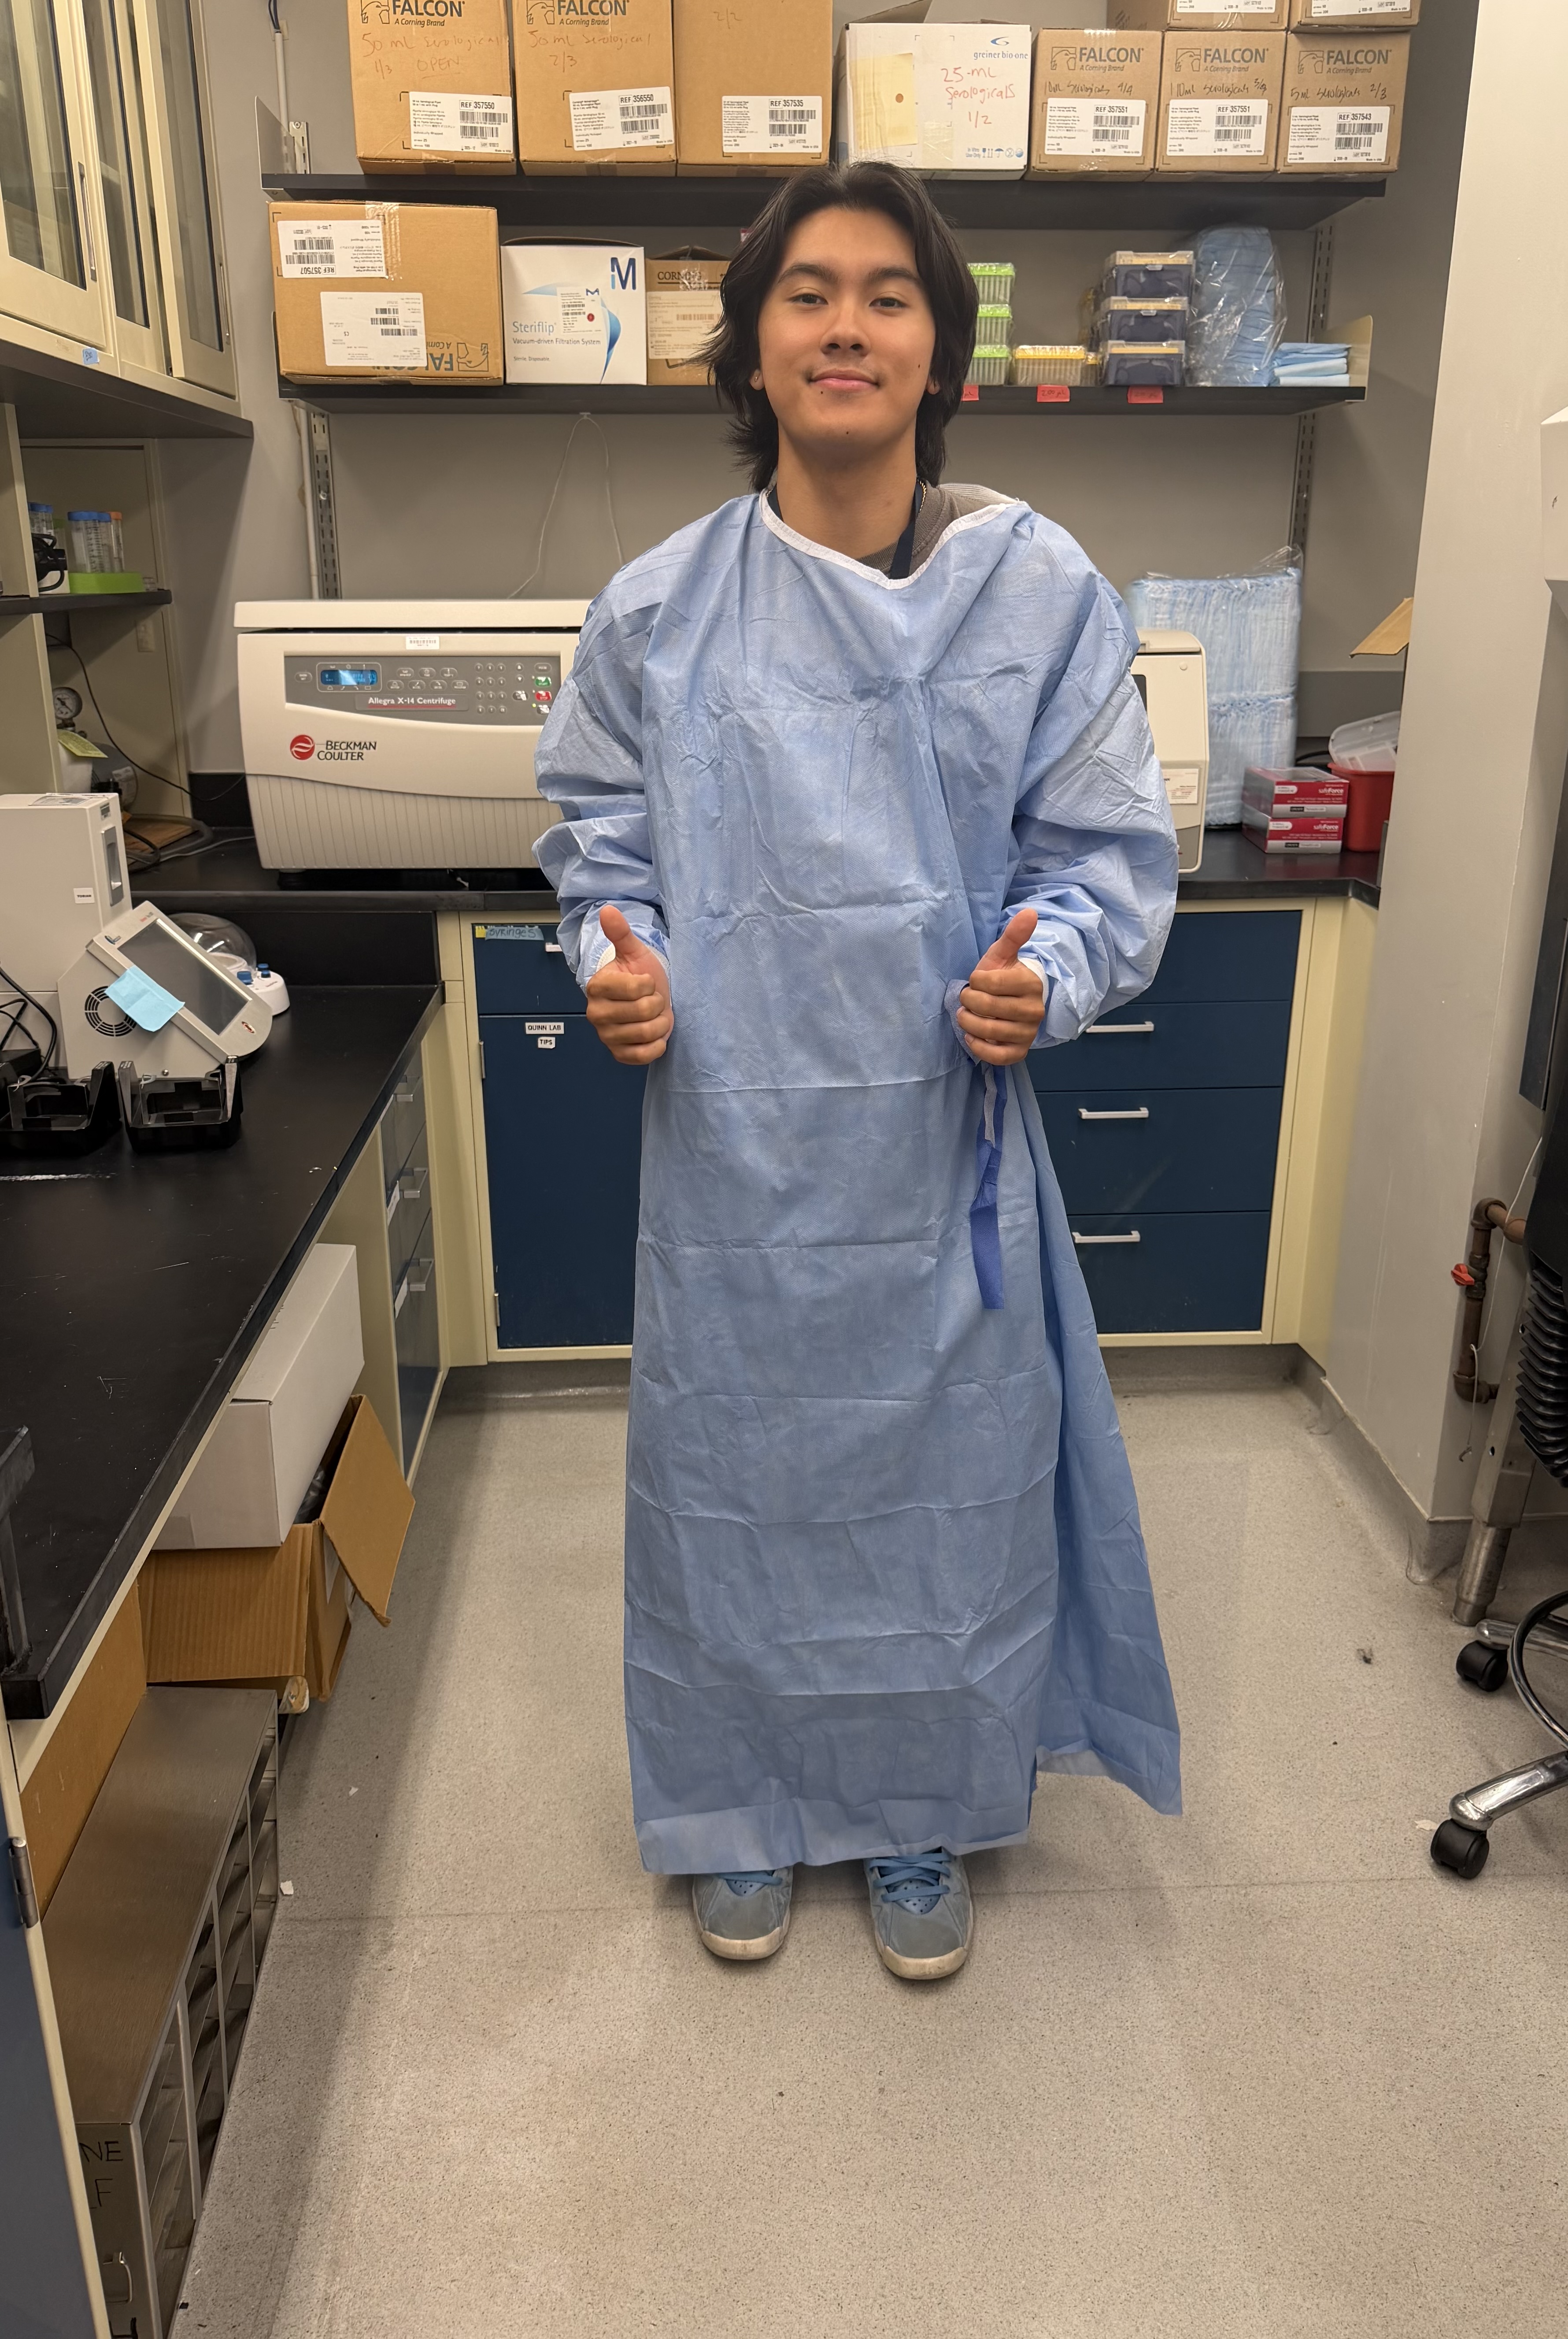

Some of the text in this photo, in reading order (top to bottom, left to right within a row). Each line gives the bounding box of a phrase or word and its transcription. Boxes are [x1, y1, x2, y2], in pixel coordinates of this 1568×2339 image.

[392, 0, 462, 17] FALCON
[557, 0, 626, 16] FALCON
[401, 19, 425, 27] Corning
[713, 8, 743, 30] 2/2
[362, 33, 383, 57] 50
[549, 51, 577, 73] 2/3
[974, 50, 1028, 60] greiner bio-one
[1079, 47, 1141, 63] FALCON
[1203, 48, 1266, 63] FALCON
[1326, 49, 1389, 65] FALCON
[375, 56, 459, 80] 1/3 OPEN
[1085, 65, 1107, 73] Corning
[1209, 66, 1231, 74] Corning
[1332, 67, 1354, 75] Corning
[632, 94, 654, 102] 356550
[1370, 82, 1387, 100] 2/3
[474, 101, 495, 109] 357550
[968, 111, 992, 129] 1/2
[512, 321, 555, 336] Steriflip
[368, 697, 395, 706] Allegra
[417, 697, 456, 706] Centrifuge
[325, 740, 377, 750] BECKMAN
[317, 750, 364, 761] COULTER
